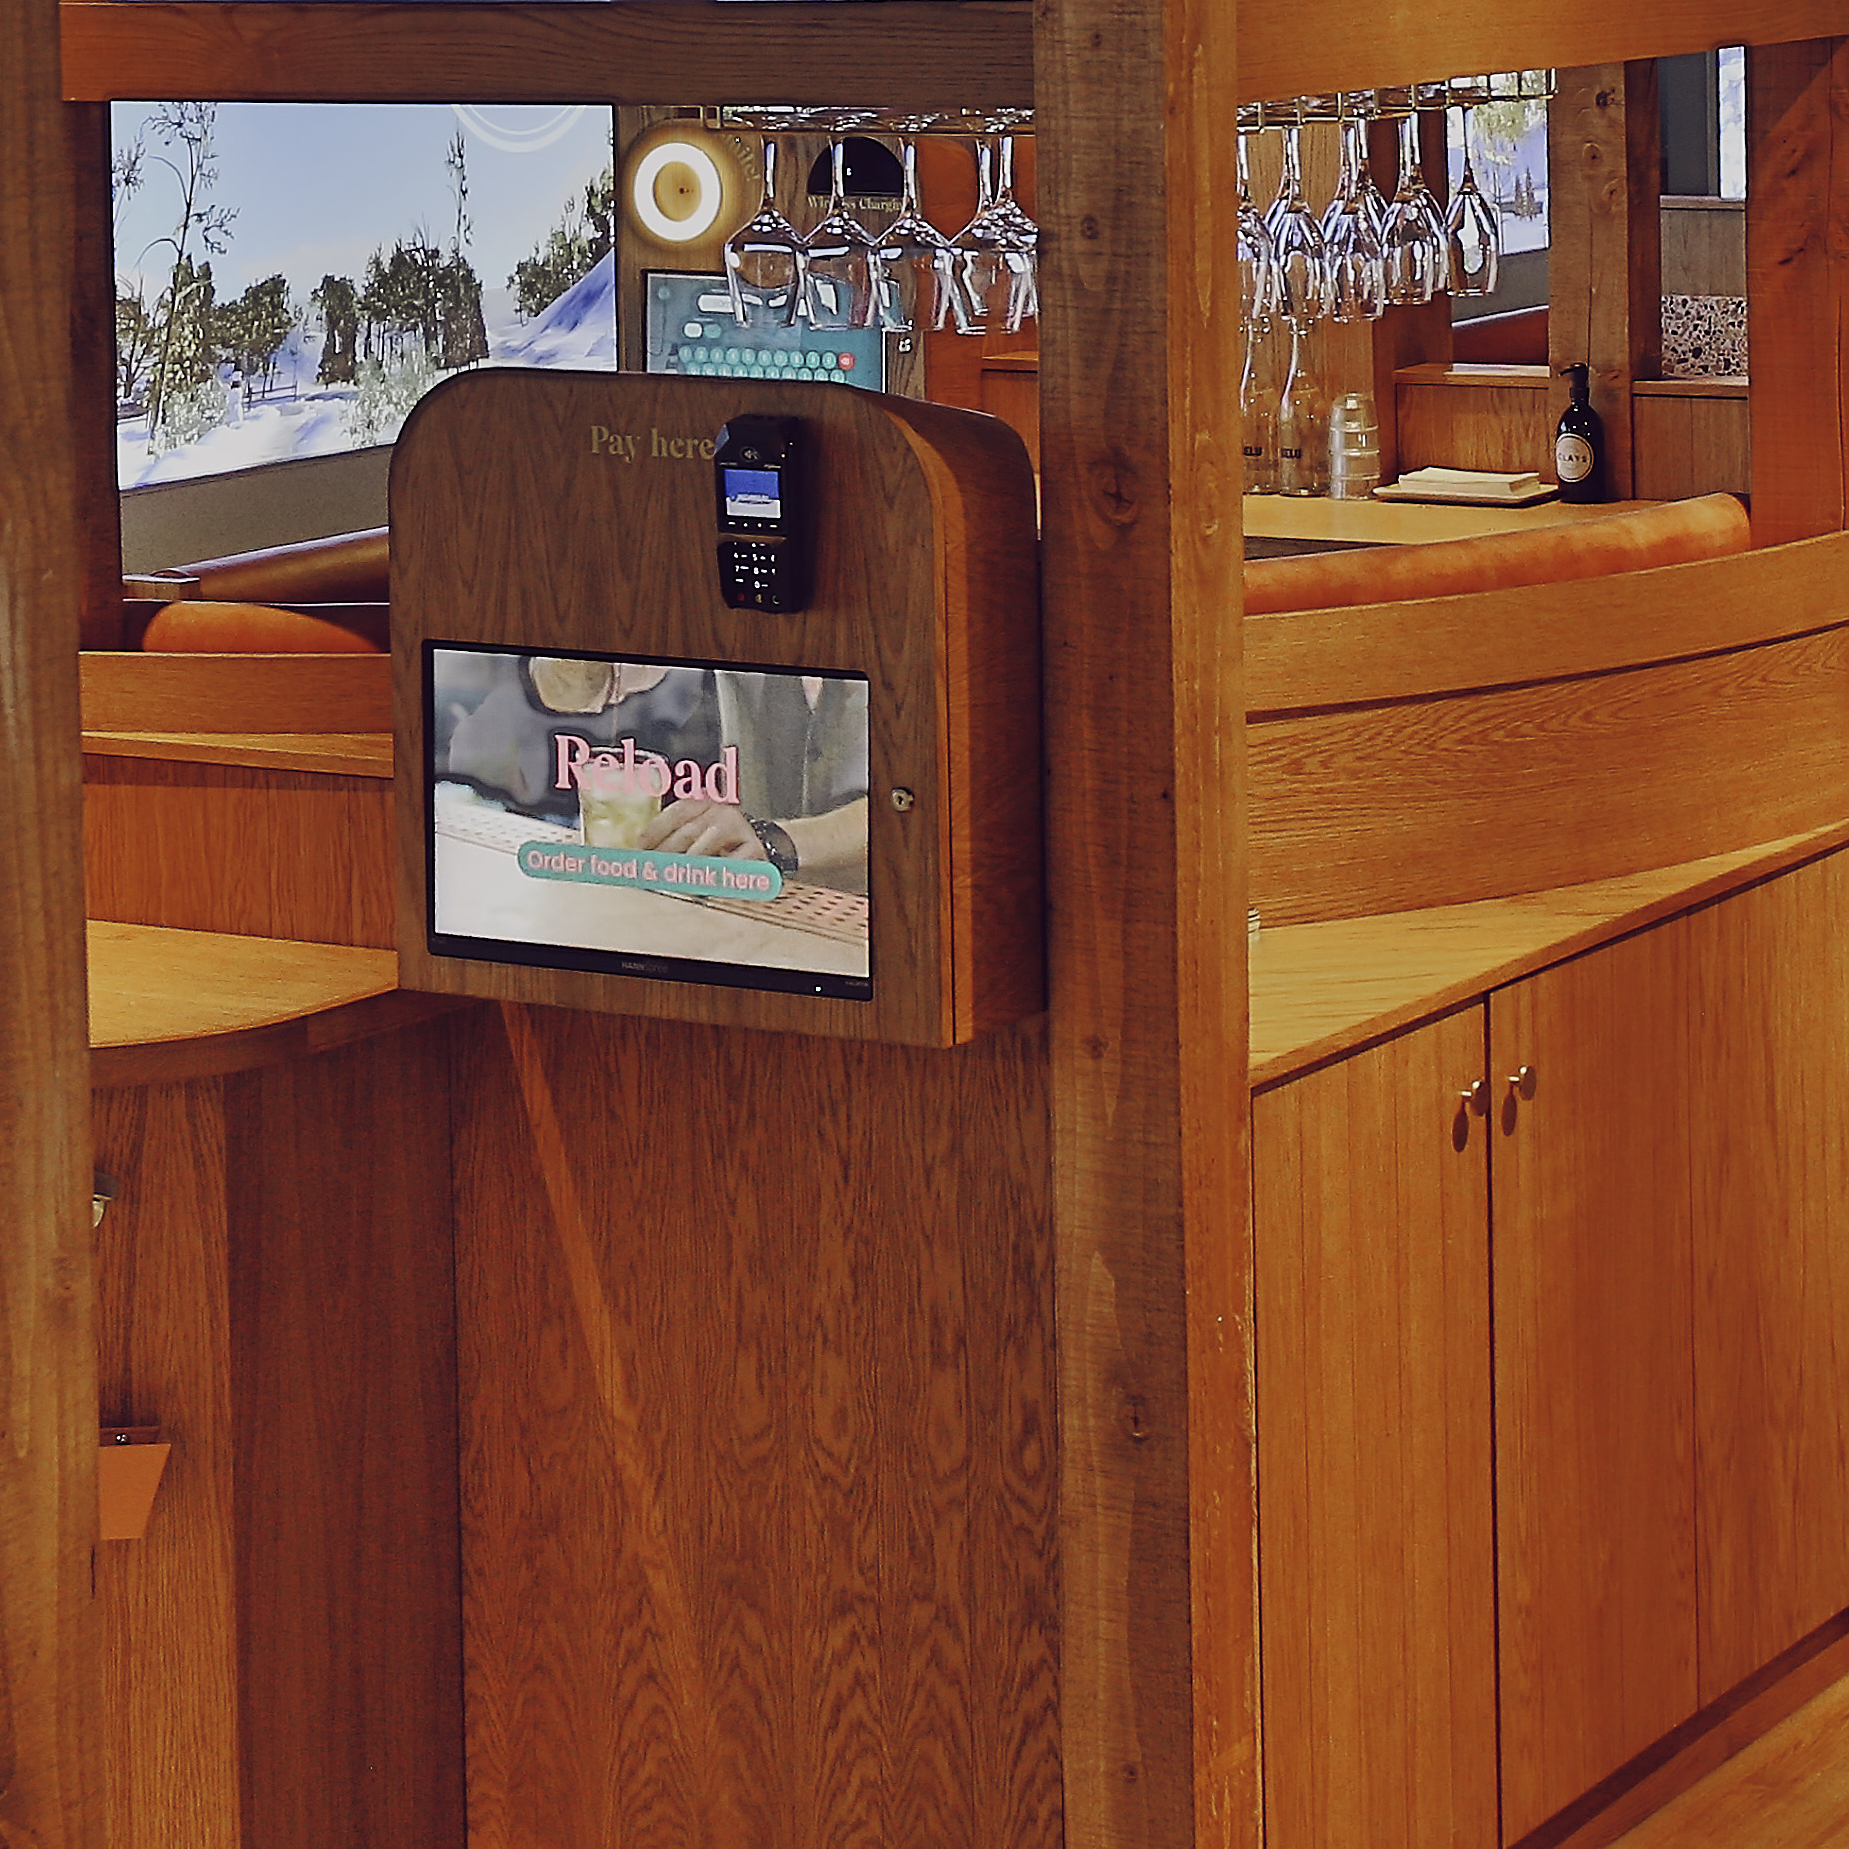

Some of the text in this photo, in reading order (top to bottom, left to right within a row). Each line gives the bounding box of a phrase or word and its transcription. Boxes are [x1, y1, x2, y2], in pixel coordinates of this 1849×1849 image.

[590, 425, 716, 463] Pay here
[554, 733, 741, 805] Reload
[526, 849, 771, 891] Order food & drink here
